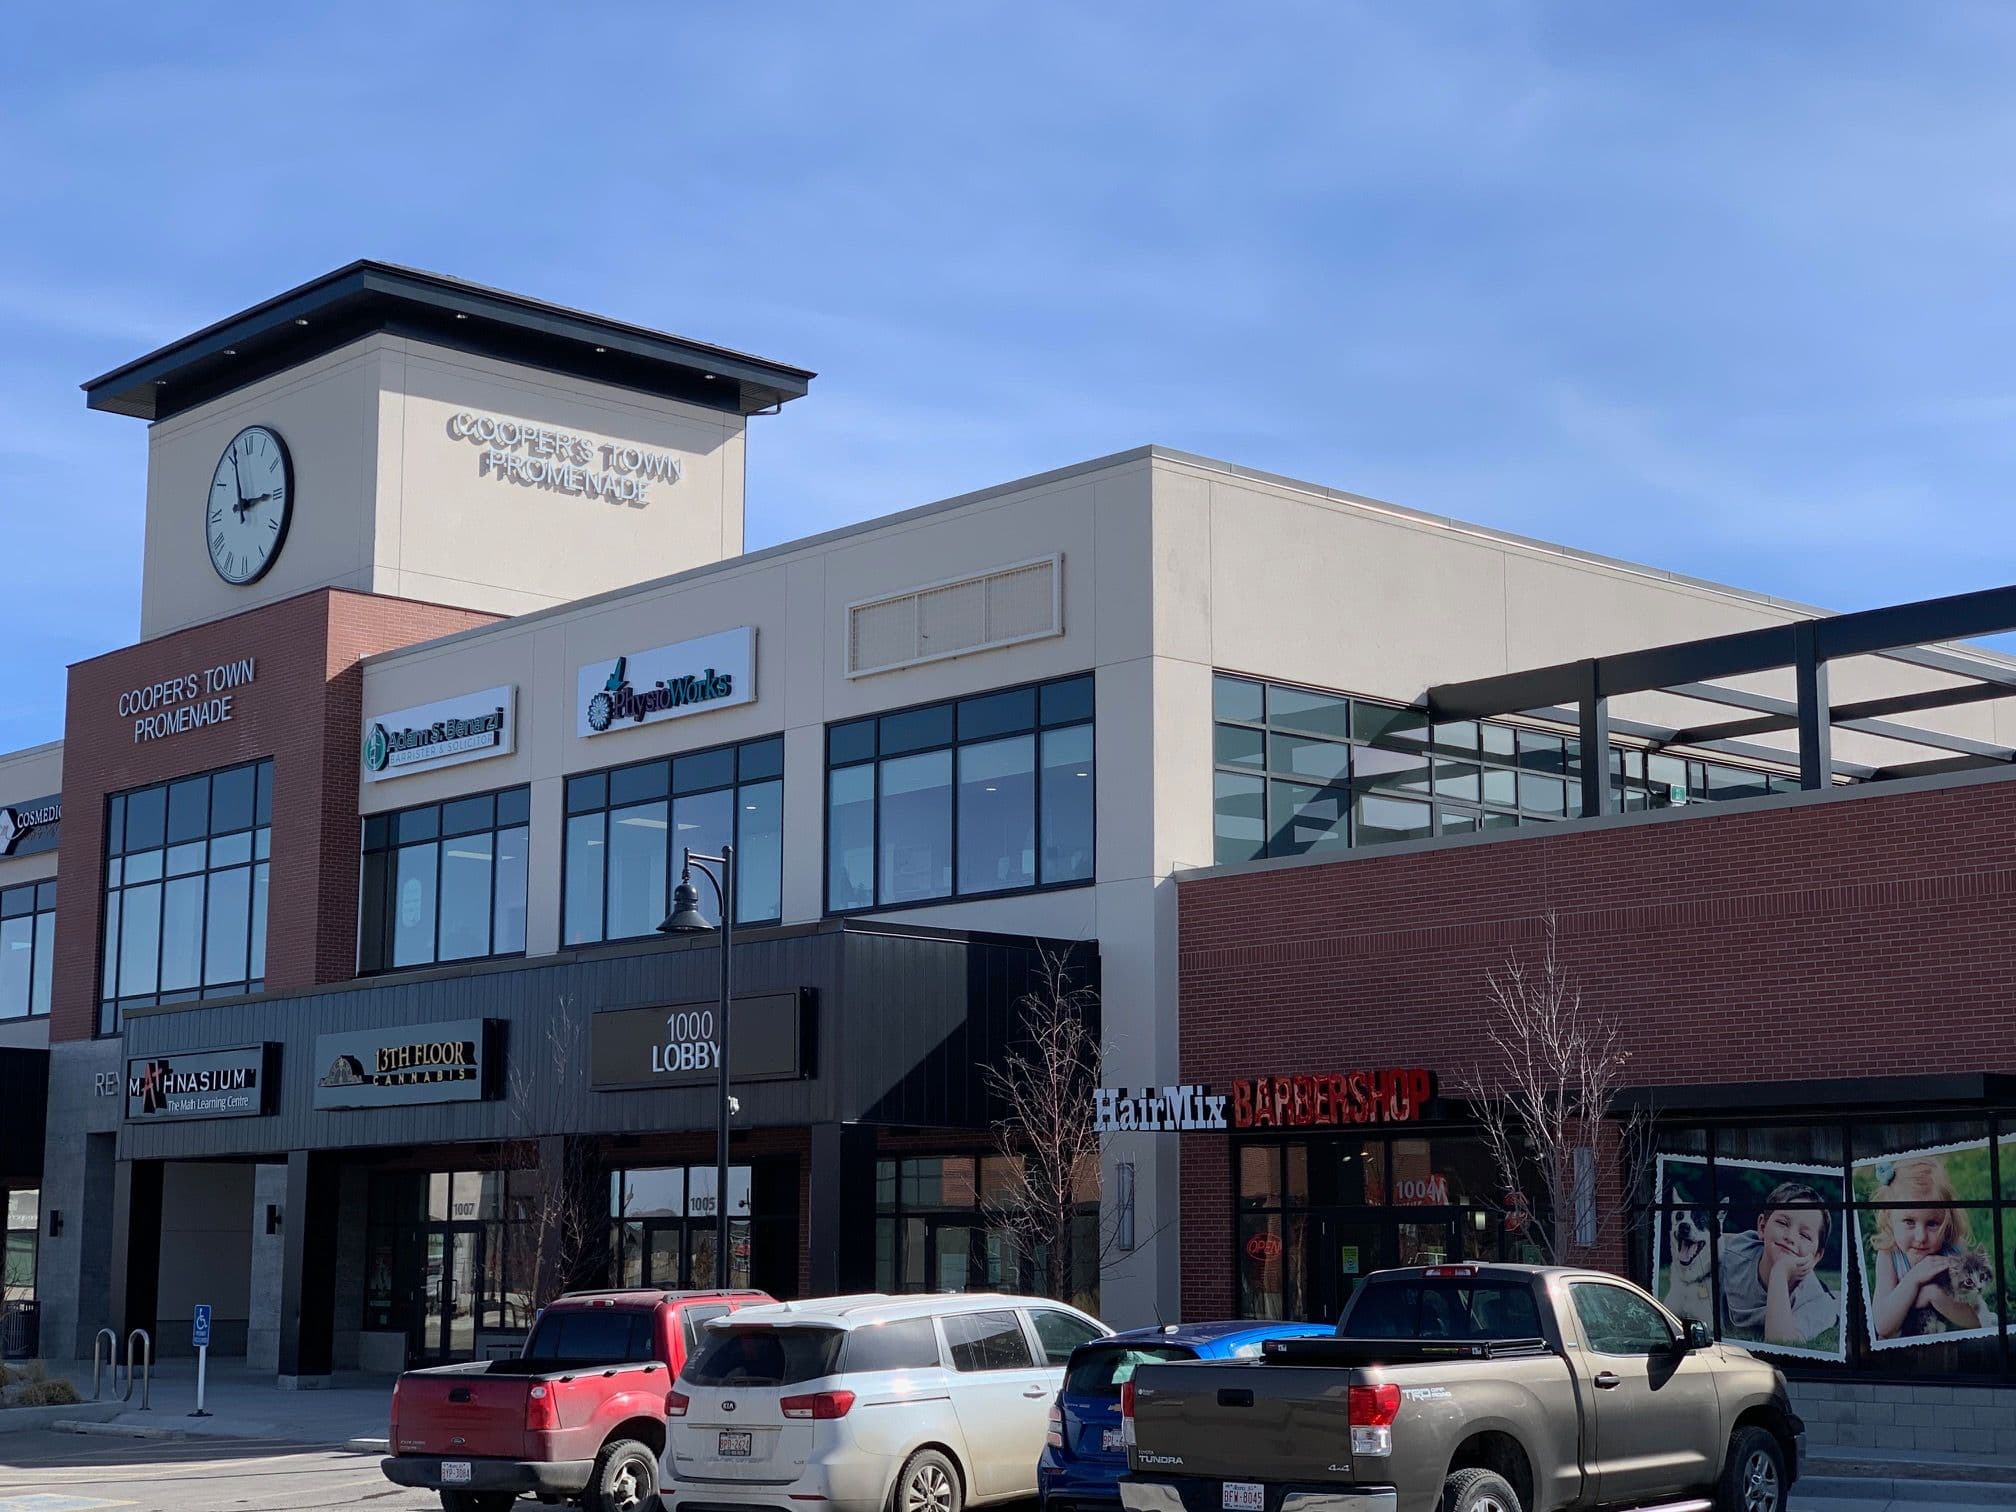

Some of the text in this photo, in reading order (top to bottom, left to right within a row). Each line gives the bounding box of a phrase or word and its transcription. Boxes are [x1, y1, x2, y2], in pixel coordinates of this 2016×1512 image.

[455, 412, 685, 481] COOPER'S TOWN
[486, 448, 650, 501] PROMENADE
[118, 657, 257, 717] COOPER'S TOWN
[612, 668, 732, 722] PhysioWorks
[134, 695, 233, 743] PROMENADE
[388, 728, 430, 751] Adam
[389, 746, 437, 764] BARRISTER
[666, 1010, 714, 1042] 1000
[375, 1041, 466, 1072] 13TH FLOOR
[652, 1041, 721, 1073] LOBBY
[372, 1068, 466, 1086] CANNABIS
[167, 1095, 249, 1112] The Math Learning Centre
[1092, 1068, 1431, 1132] HairMix BARBERSHOP
[453, 1202, 476, 1217] 1007
[690, 1196, 716, 1212] 1005
[1249, 1239, 1280, 1255] OPEN
[722, 1402, 735, 1410] KIA
[1138, 1455, 1184, 1465] TUNDRA
[1224, 1490, 1263, 1505] BFW-8045
